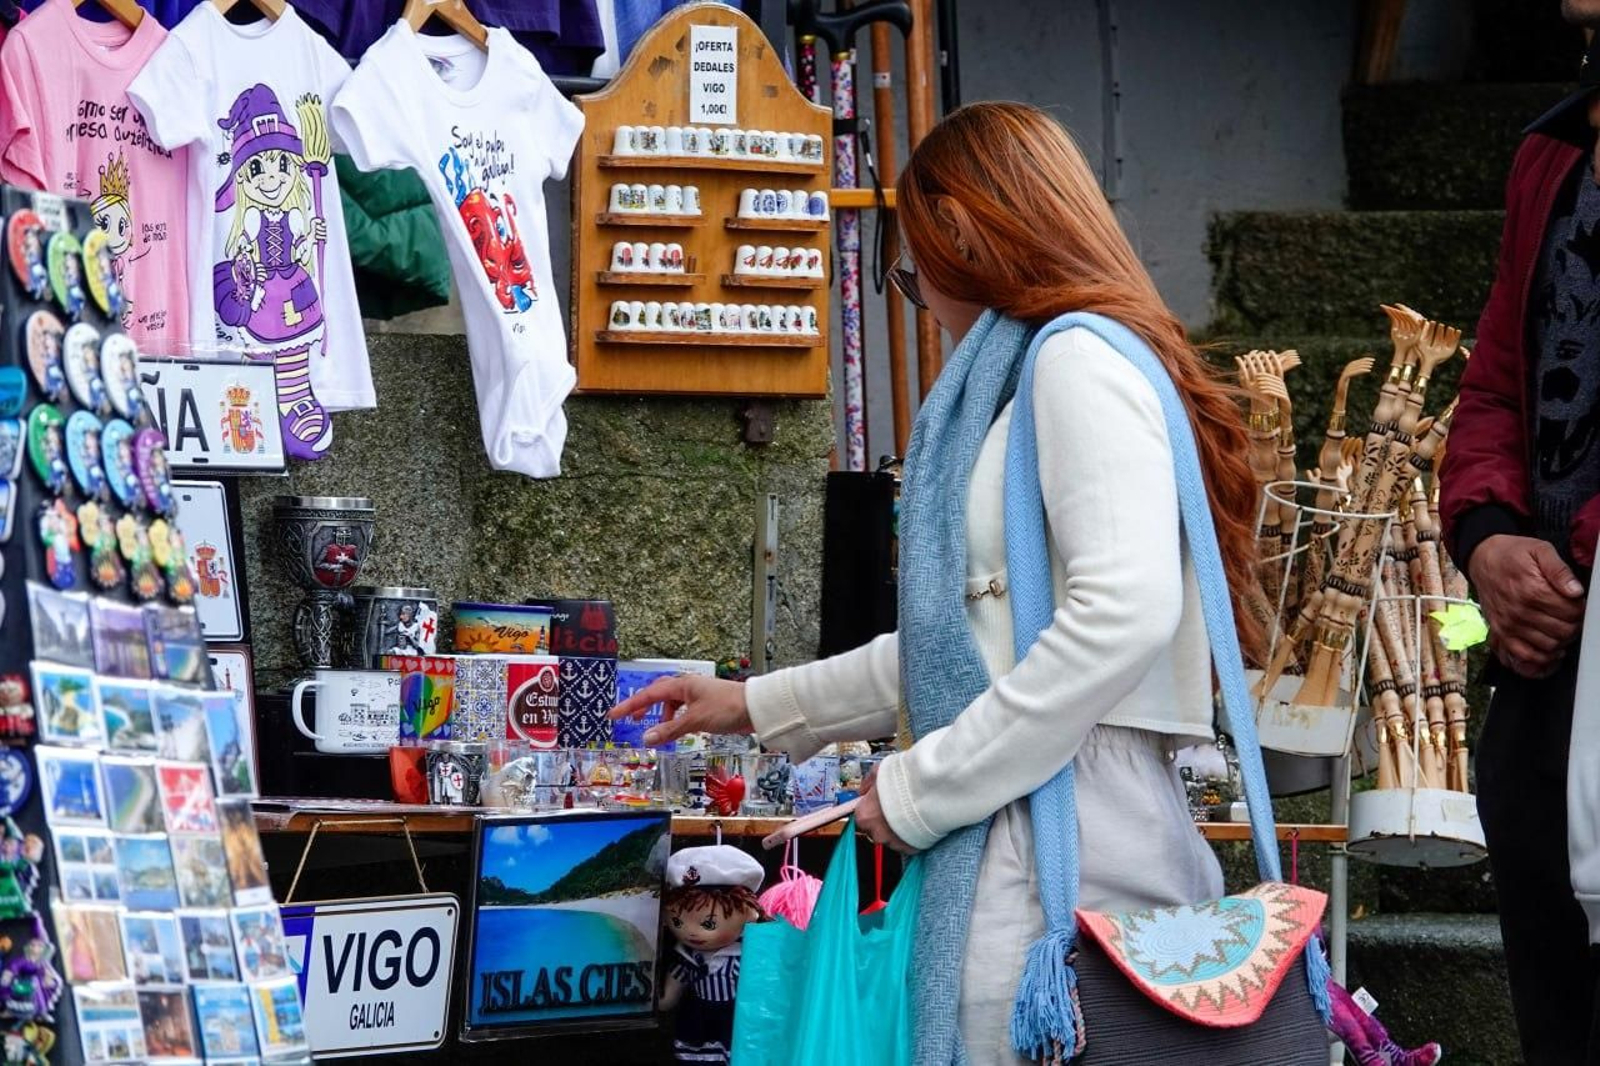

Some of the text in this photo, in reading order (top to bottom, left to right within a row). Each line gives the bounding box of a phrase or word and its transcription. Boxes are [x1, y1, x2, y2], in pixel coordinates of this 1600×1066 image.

[695, 41, 733, 52] ¡OFERTA
[694, 62, 735, 73] DEDALES
[703, 83, 726, 94] VIGO
[77, 99, 106, 119] ómo
[109, 104, 129, 124] ser
[451, 125, 474, 159] Soy
[493, 624, 530, 642] Vigo
[550, 624, 618, 652] licia
[417, 696, 441, 717] Vigo
[522, 709, 559, 727] en Vig
[322, 926, 442, 994] VIGO
[479, 966, 573, 1014] ISLAS
[349, 1000, 396, 1031] GALICIA
